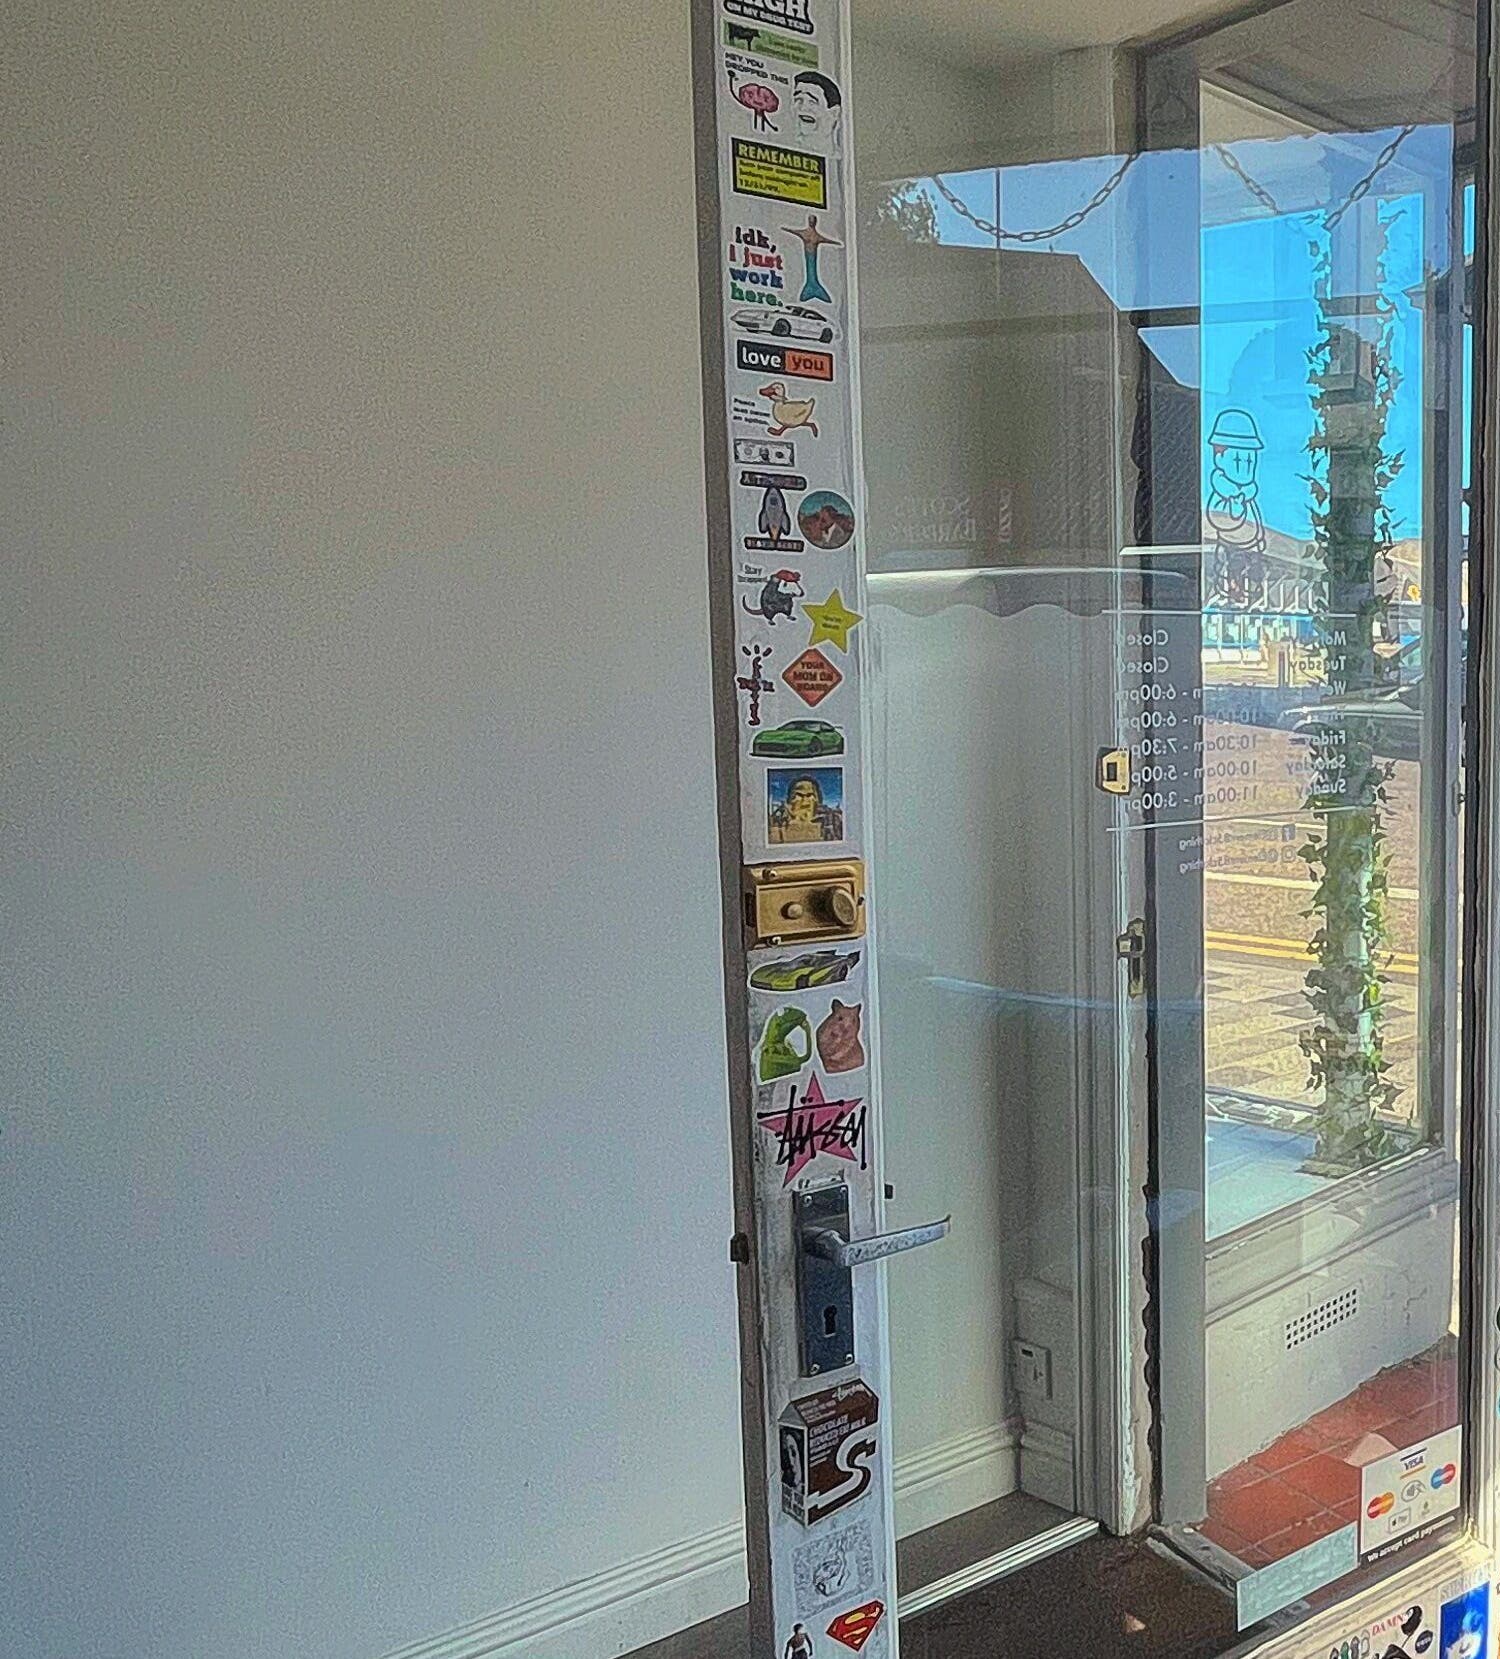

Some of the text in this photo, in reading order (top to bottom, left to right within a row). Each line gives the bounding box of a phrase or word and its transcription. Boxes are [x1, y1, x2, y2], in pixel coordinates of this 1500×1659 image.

[744, 57, 764, 68] YOU
[738, 143, 819, 172] REMEMBER
[743, 247, 783, 270] just
[729, 268, 783, 289] work
[730, 281, 784, 307] here.
[742, 347, 782, 368] love
[792, 356, 825, 374] you
[793, 671, 817, 681] MOM
[1404, 1456, 1424, 1470] VISA
